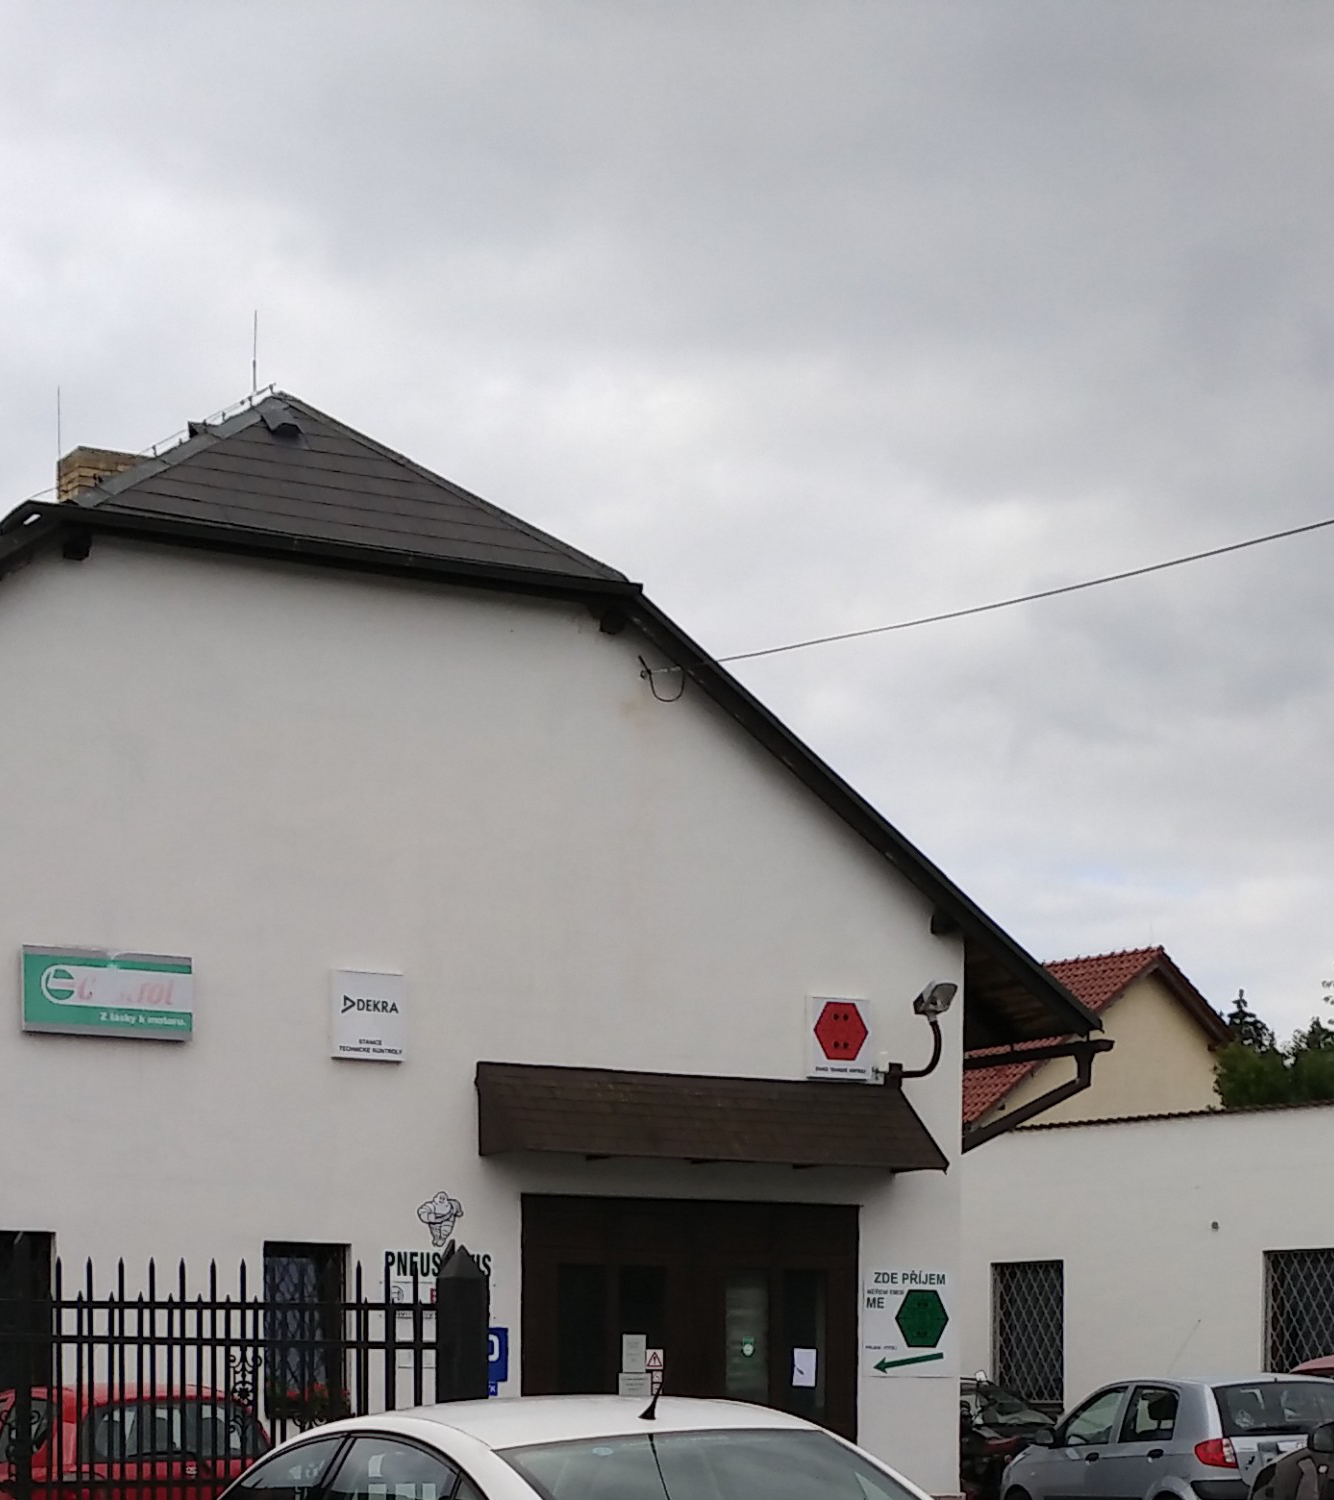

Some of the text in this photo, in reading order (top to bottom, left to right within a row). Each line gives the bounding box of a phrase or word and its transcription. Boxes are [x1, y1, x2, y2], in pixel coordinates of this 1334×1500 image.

[356, 998, 399, 1014] DEKRA
[100, 1011, 108, 1021] Z
[874, 1270, 946, 1285] ZDE PŘÍJEM
[866, 1297, 884, 1309] ME
